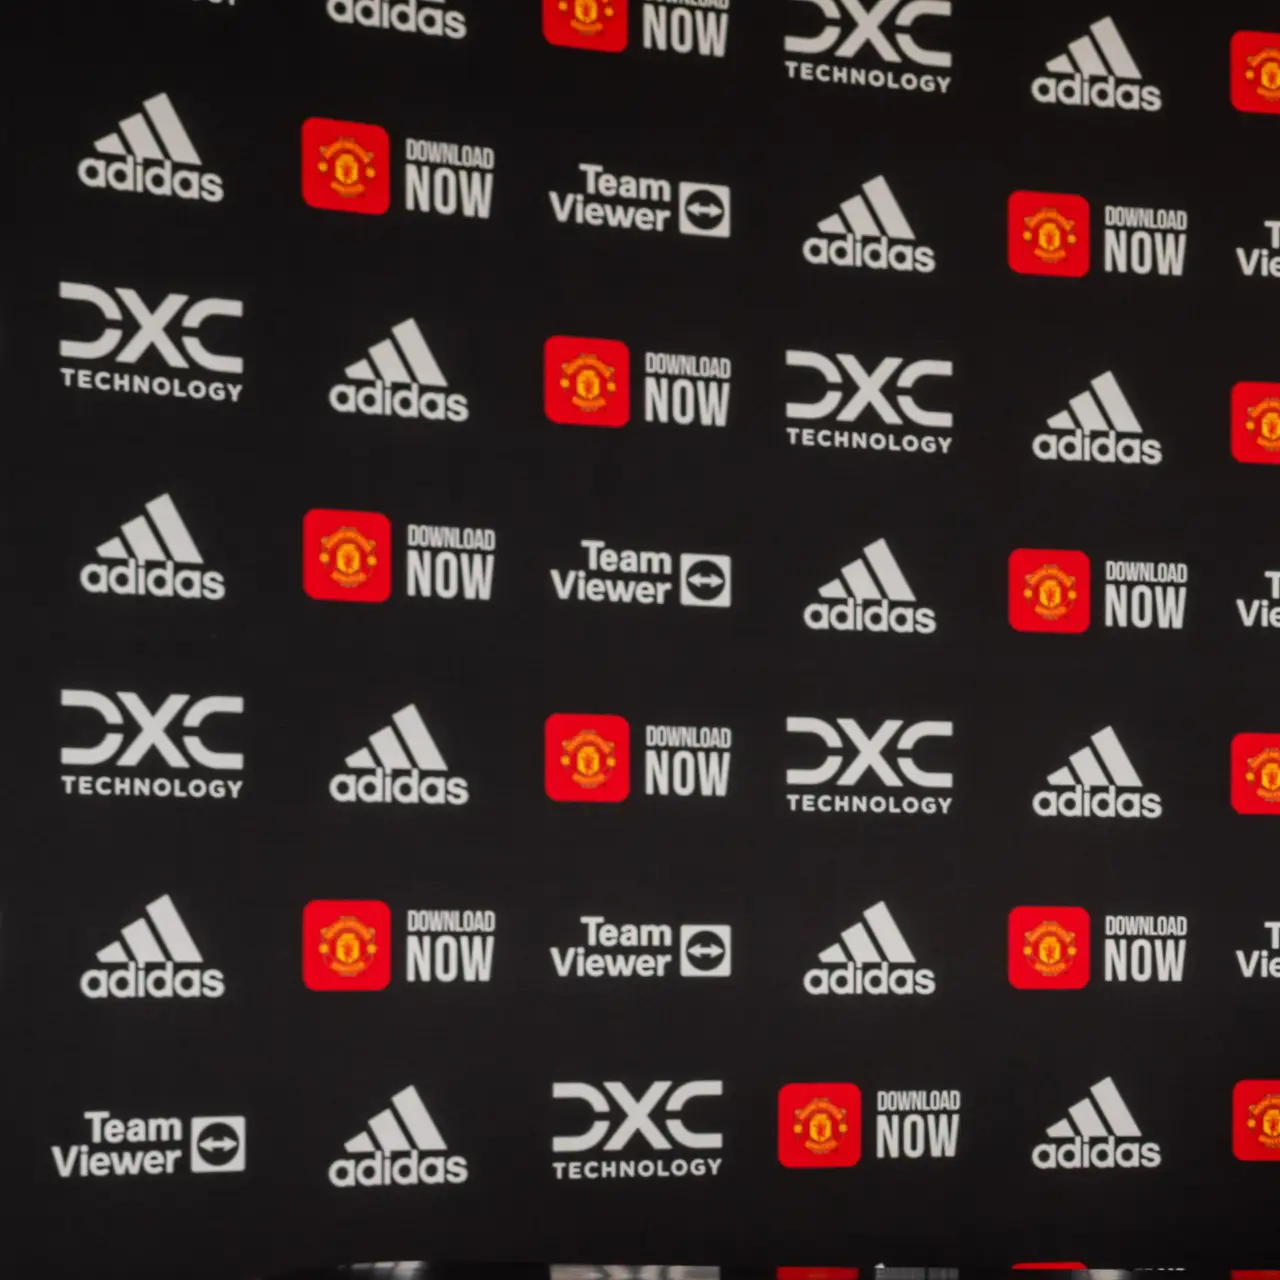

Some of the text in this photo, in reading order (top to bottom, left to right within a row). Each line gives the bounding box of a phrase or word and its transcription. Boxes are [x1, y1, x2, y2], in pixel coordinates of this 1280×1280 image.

[326, 0, 468, 40] adidas
[643, 3, 729, 58] NOW
[784, 60, 951, 93] TECHNOLOGY
[1031, 72, 1162, 112] adidas
[77, 154, 224, 203] adidas
[405, 163, 494, 219] NOW
[578, 163, 672, 202] Team
[548, 190, 672, 232] Viewer
[802, 232, 936, 273] adidas
[1104, 228, 1187, 276] NOW
[59, 281, 244, 374] DXC
[60, 367, 243, 402] TECHNOLOGY
[328, 379, 469, 422] adidas
[644, 376, 730, 427] NOW
[785, 349, 954, 428] DXC
[786, 427, 953, 454] TECHNOLOGY
[1031, 427, 1163, 465] adidas
[407, 523, 496, 552] DOWNLOAD
[580, 539, 673, 575] Team
[79, 558, 226, 601] adidas
[406, 549, 495, 601] NOW
[549, 568, 673, 605] Viewer
[1105, 560, 1188, 584] DOWNLOAD
[803, 596, 937, 635] adidas
[1104, 583, 1187, 630] NOW
[60, 688, 244, 771] DXC
[645, 724, 732, 749] DOWNLOAD
[785, 716, 954, 789] DXC
[60, 775, 243, 799] TECHNOLOGY
[328, 767, 470, 806] adidas
[645, 749, 731, 797] NOW
[786, 793, 953, 815] TECHNOLOGY
[1031, 783, 1163, 819] adidas
[406, 909, 496, 933] DOWNLOAD
[579, 915, 673, 948] Team
[406, 934, 495, 983] NOW
[549, 946, 673, 978] Viewer
[1104, 938, 1187, 983] NOW
[79, 960, 226, 999] adidas
[802, 961, 936, 996] adidas
[552, 1079, 723, 1153] DXC
[876, 1089, 961, 1112] DOWNLOAD
[83, 1110, 183, 1144] Team
[876, 1113, 960, 1159] NOW
[50, 1143, 183, 1178] Viewer
[328, 1148, 469, 1188] adidas
[552, 1158, 722, 1180] TECHNOLOGY
[1031, 1135, 1162, 1170] adidas
